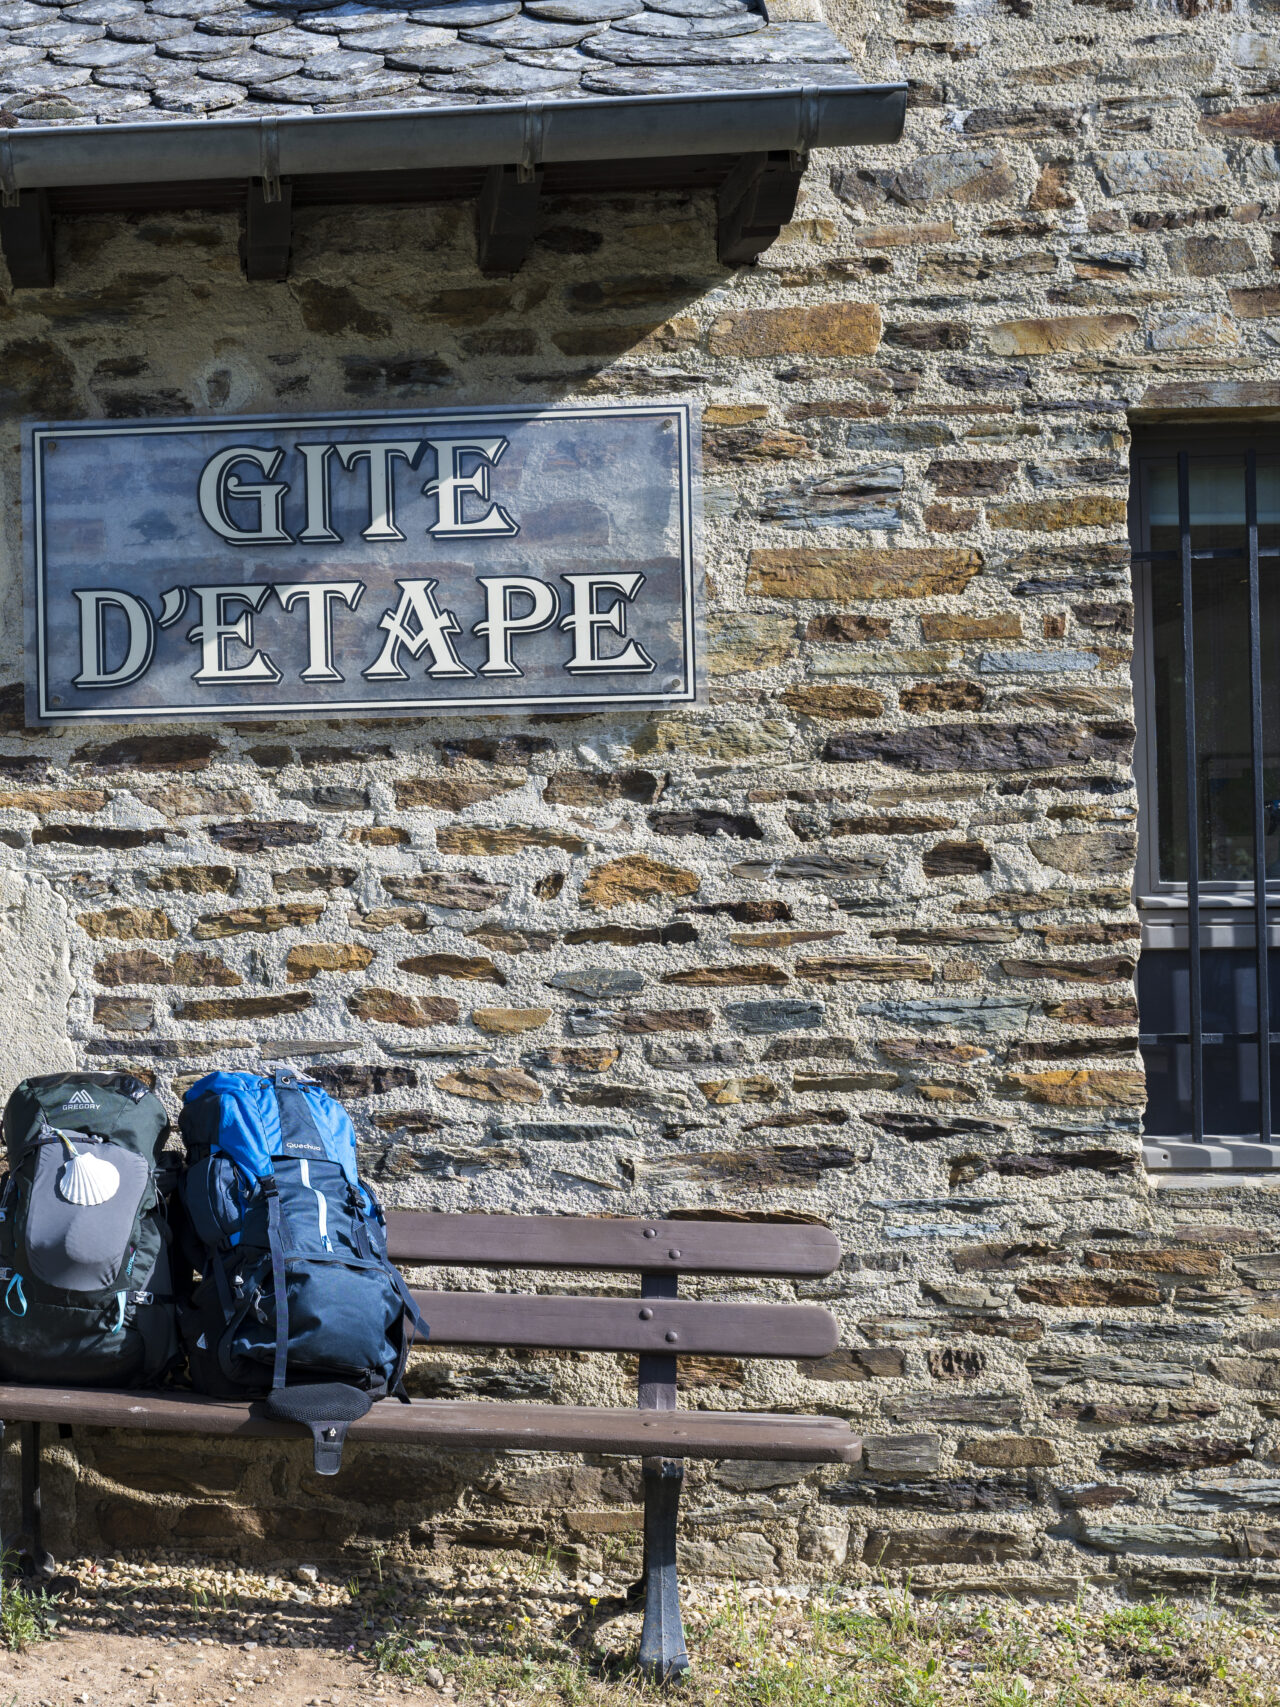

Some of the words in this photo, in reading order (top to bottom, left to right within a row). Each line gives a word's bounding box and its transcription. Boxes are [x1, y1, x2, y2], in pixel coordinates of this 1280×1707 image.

[198, 434, 520, 546] GITE
[71, 571, 659, 690] D'ETAPE
[62, 1103, 101, 1111] GREGORY
[286, 1142, 321, 1151] Quechua
